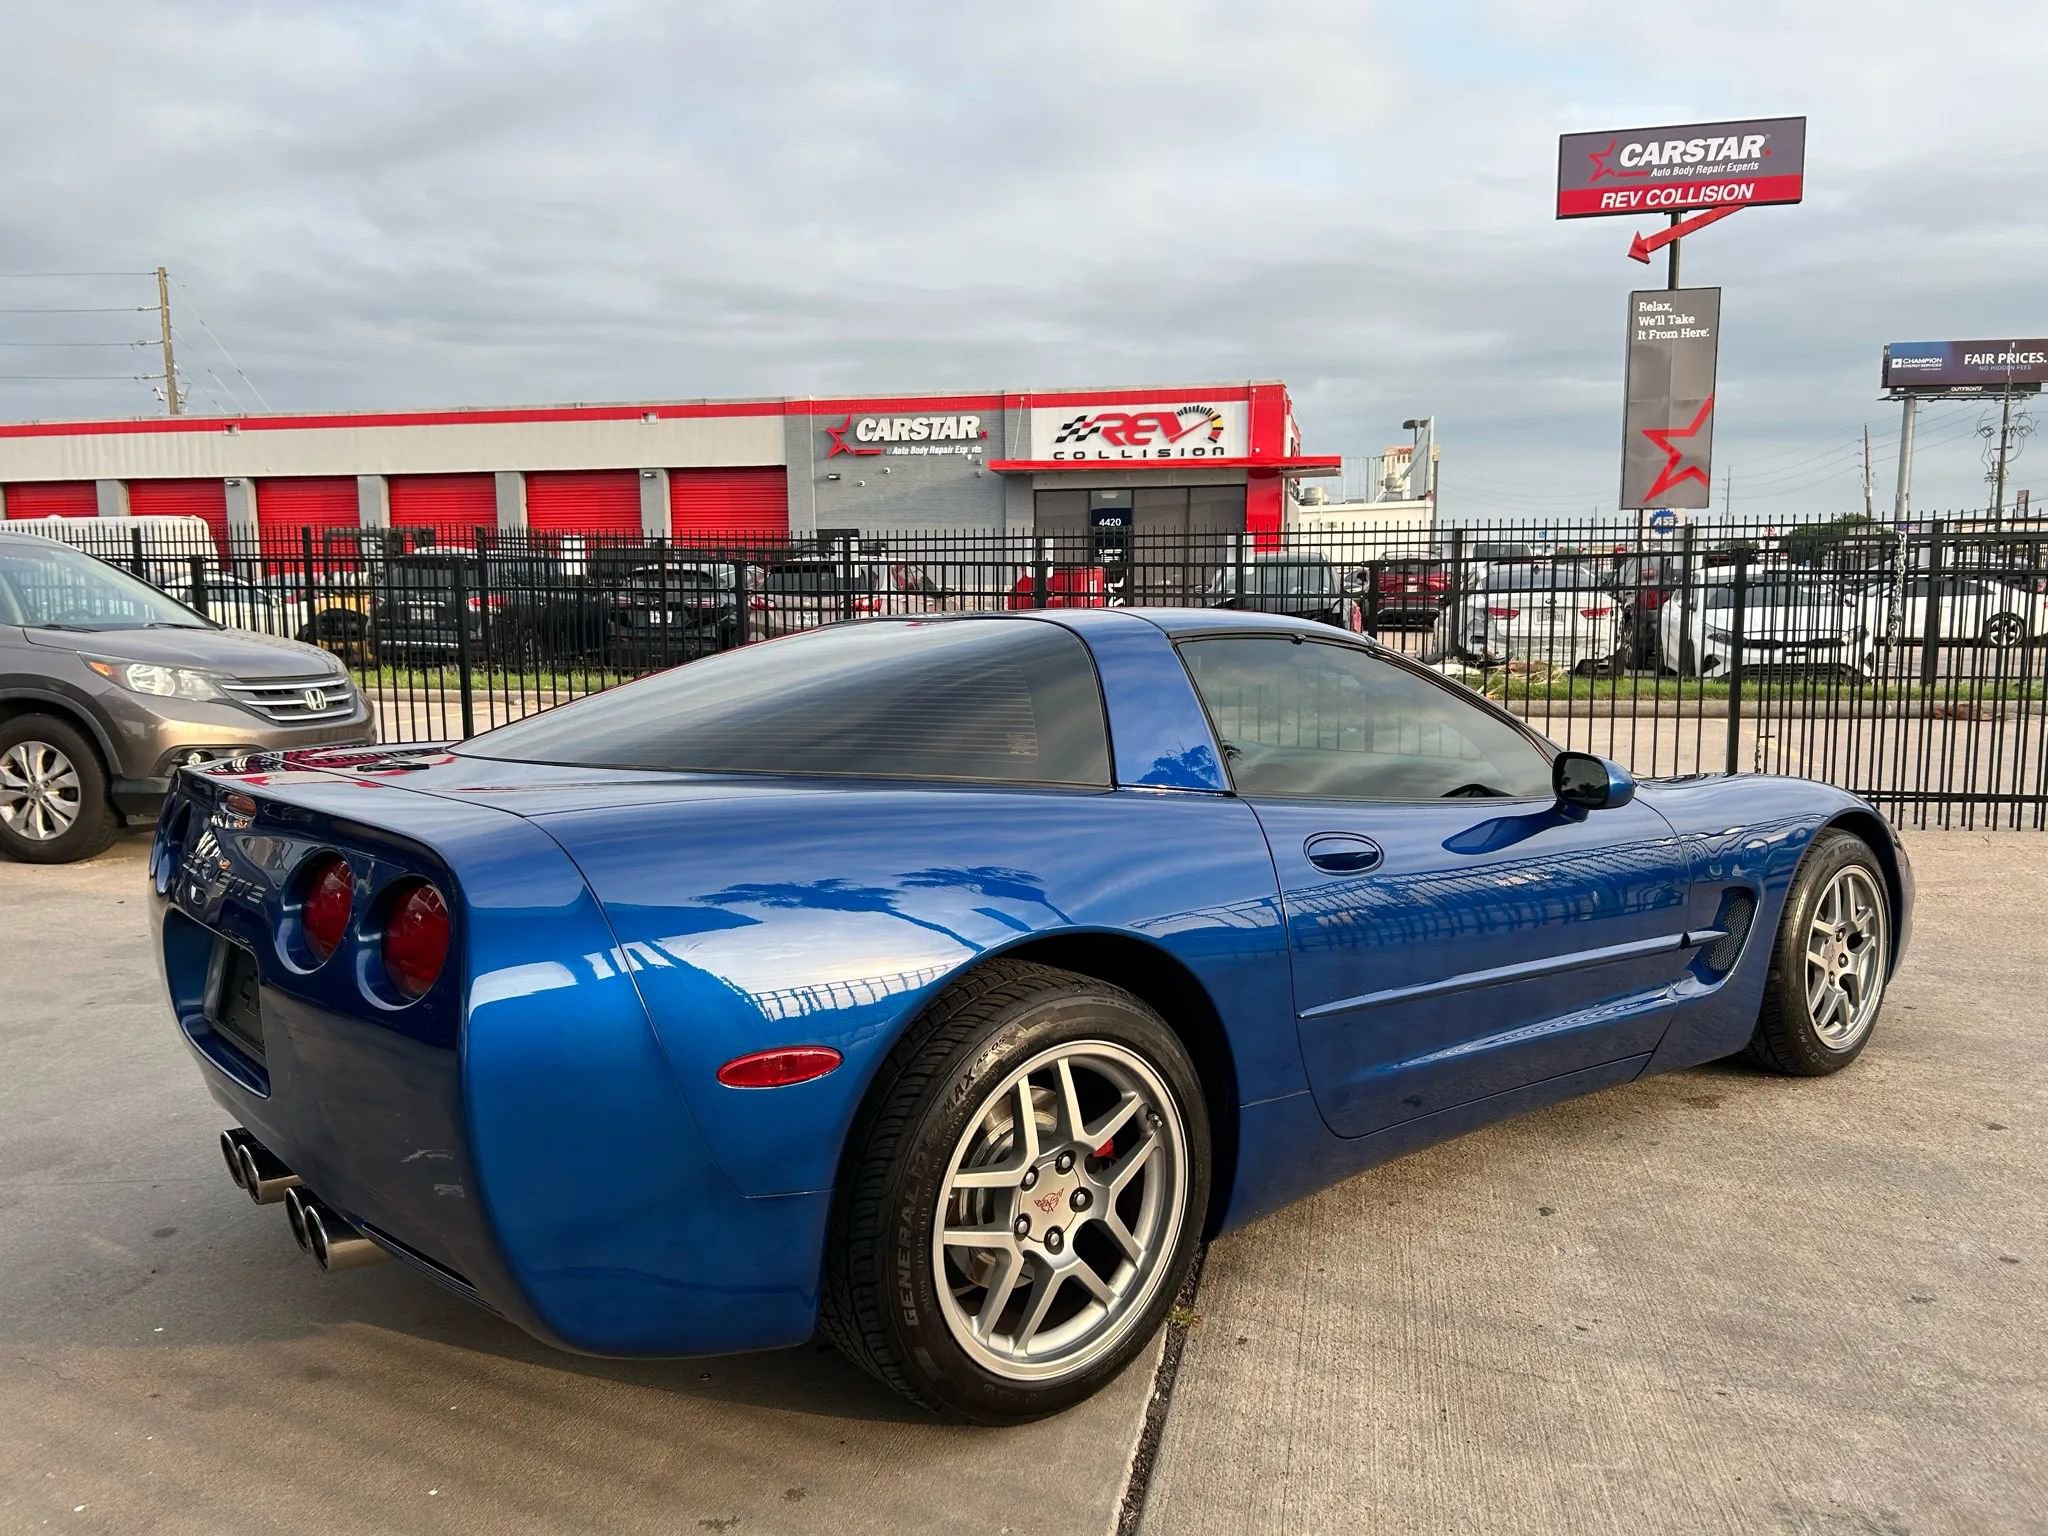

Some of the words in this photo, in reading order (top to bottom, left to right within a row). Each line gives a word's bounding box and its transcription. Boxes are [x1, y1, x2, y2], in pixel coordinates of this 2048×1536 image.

[1619, 134, 1766, 167] CARSTAR
[1650, 166, 1671, 177] Auto
[1673, 165, 1694, 177] Body
[1696, 162, 1726, 176] Repair
[1726, 160, 1759, 174] Experts
[1600, 190, 1643, 209] REV
[1645, 183, 1755, 206] COLLISION
[1638, 301, 1673, 313] Relax,
[1638, 315, 1665, 326] We'll
[1667, 313, 1696, 325] Take
[1637, 330, 1646, 340] It
[1648, 329, 1678, 340] From
[1964, 353, 1995, 365] FAIR
[1997, 352, 2048, 364] PRICES.
[856, 415, 981, 442] CARSTAR
[1095, 411, 1184, 447] REV
[892, 446, 909, 455] Auto
[910, 446, 929, 456] Body
[929, 445, 954, 455] Repair
[1053, 446, 1225, 461] COLLISION
[1099, 518, 1122, 527] 4420
